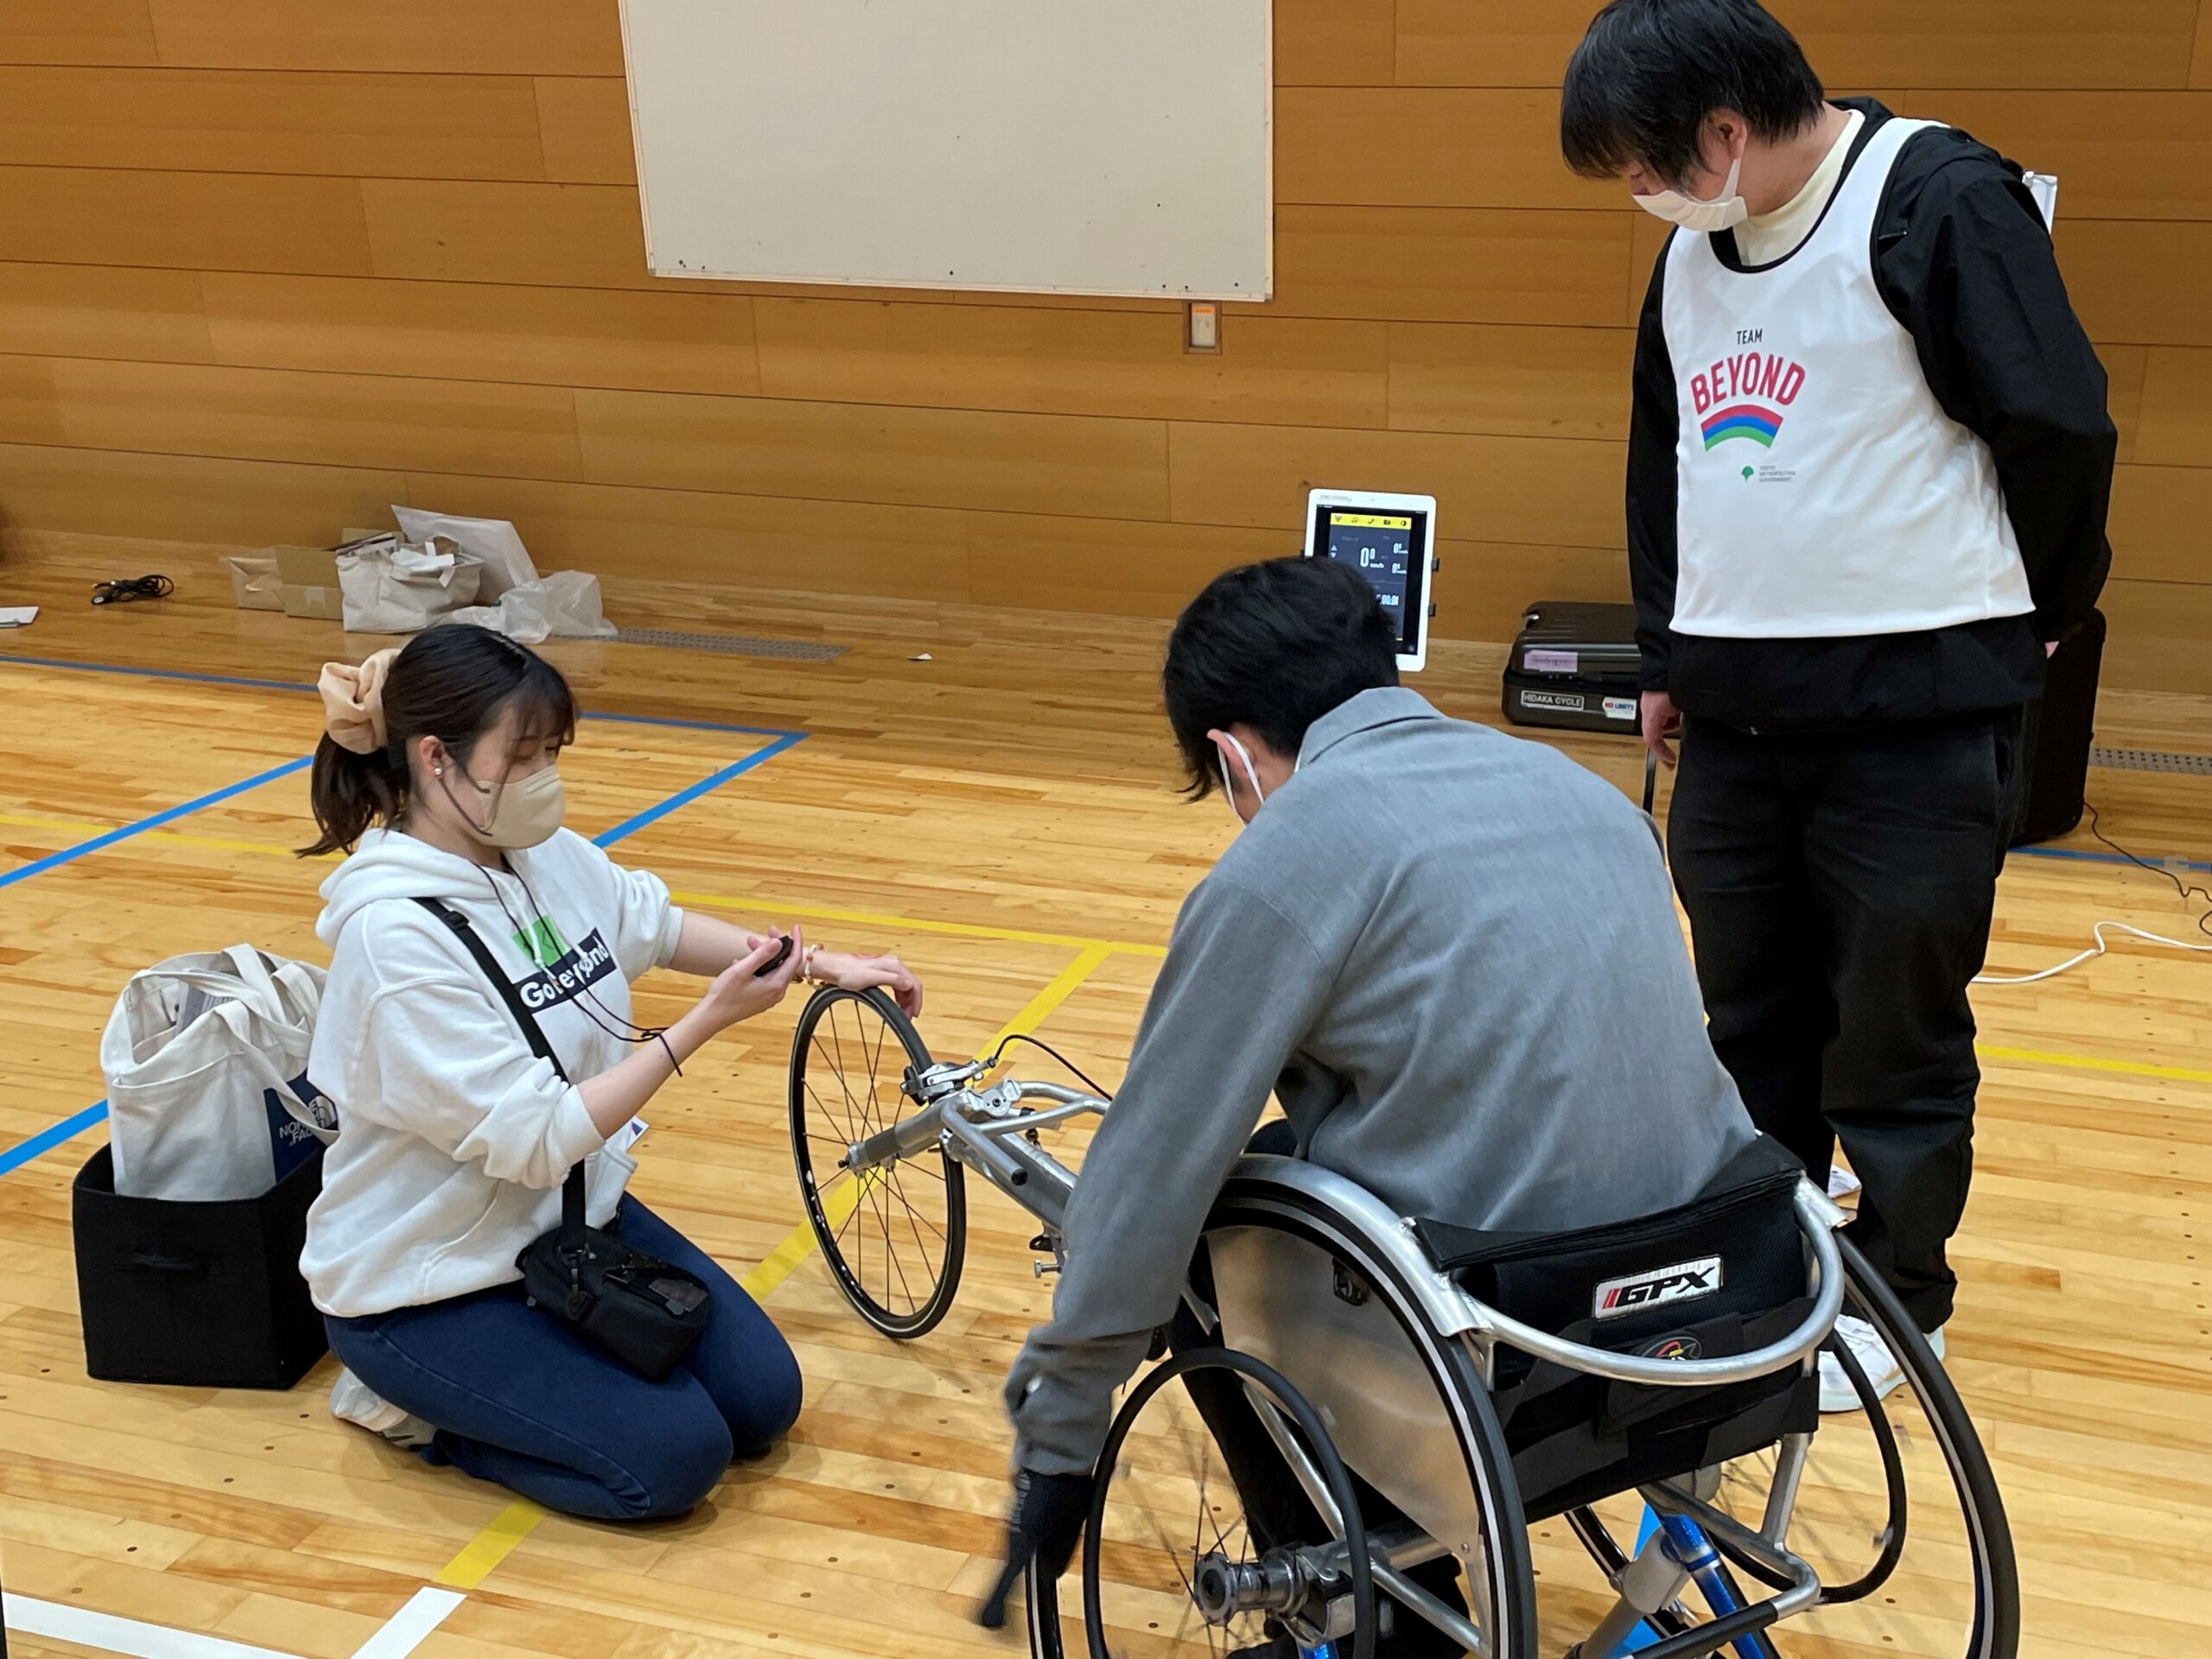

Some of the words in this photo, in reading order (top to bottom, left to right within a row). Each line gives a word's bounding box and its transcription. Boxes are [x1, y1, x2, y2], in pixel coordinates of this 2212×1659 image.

[1737, 328, 1763, 345] TEAM
[1690, 352, 1806, 416] BEYOND
[1523, 693, 1554, 704] HIDAKA
[1555, 696, 1582, 707] CYCLE
[1614, 1266, 1716, 1308] GPX
